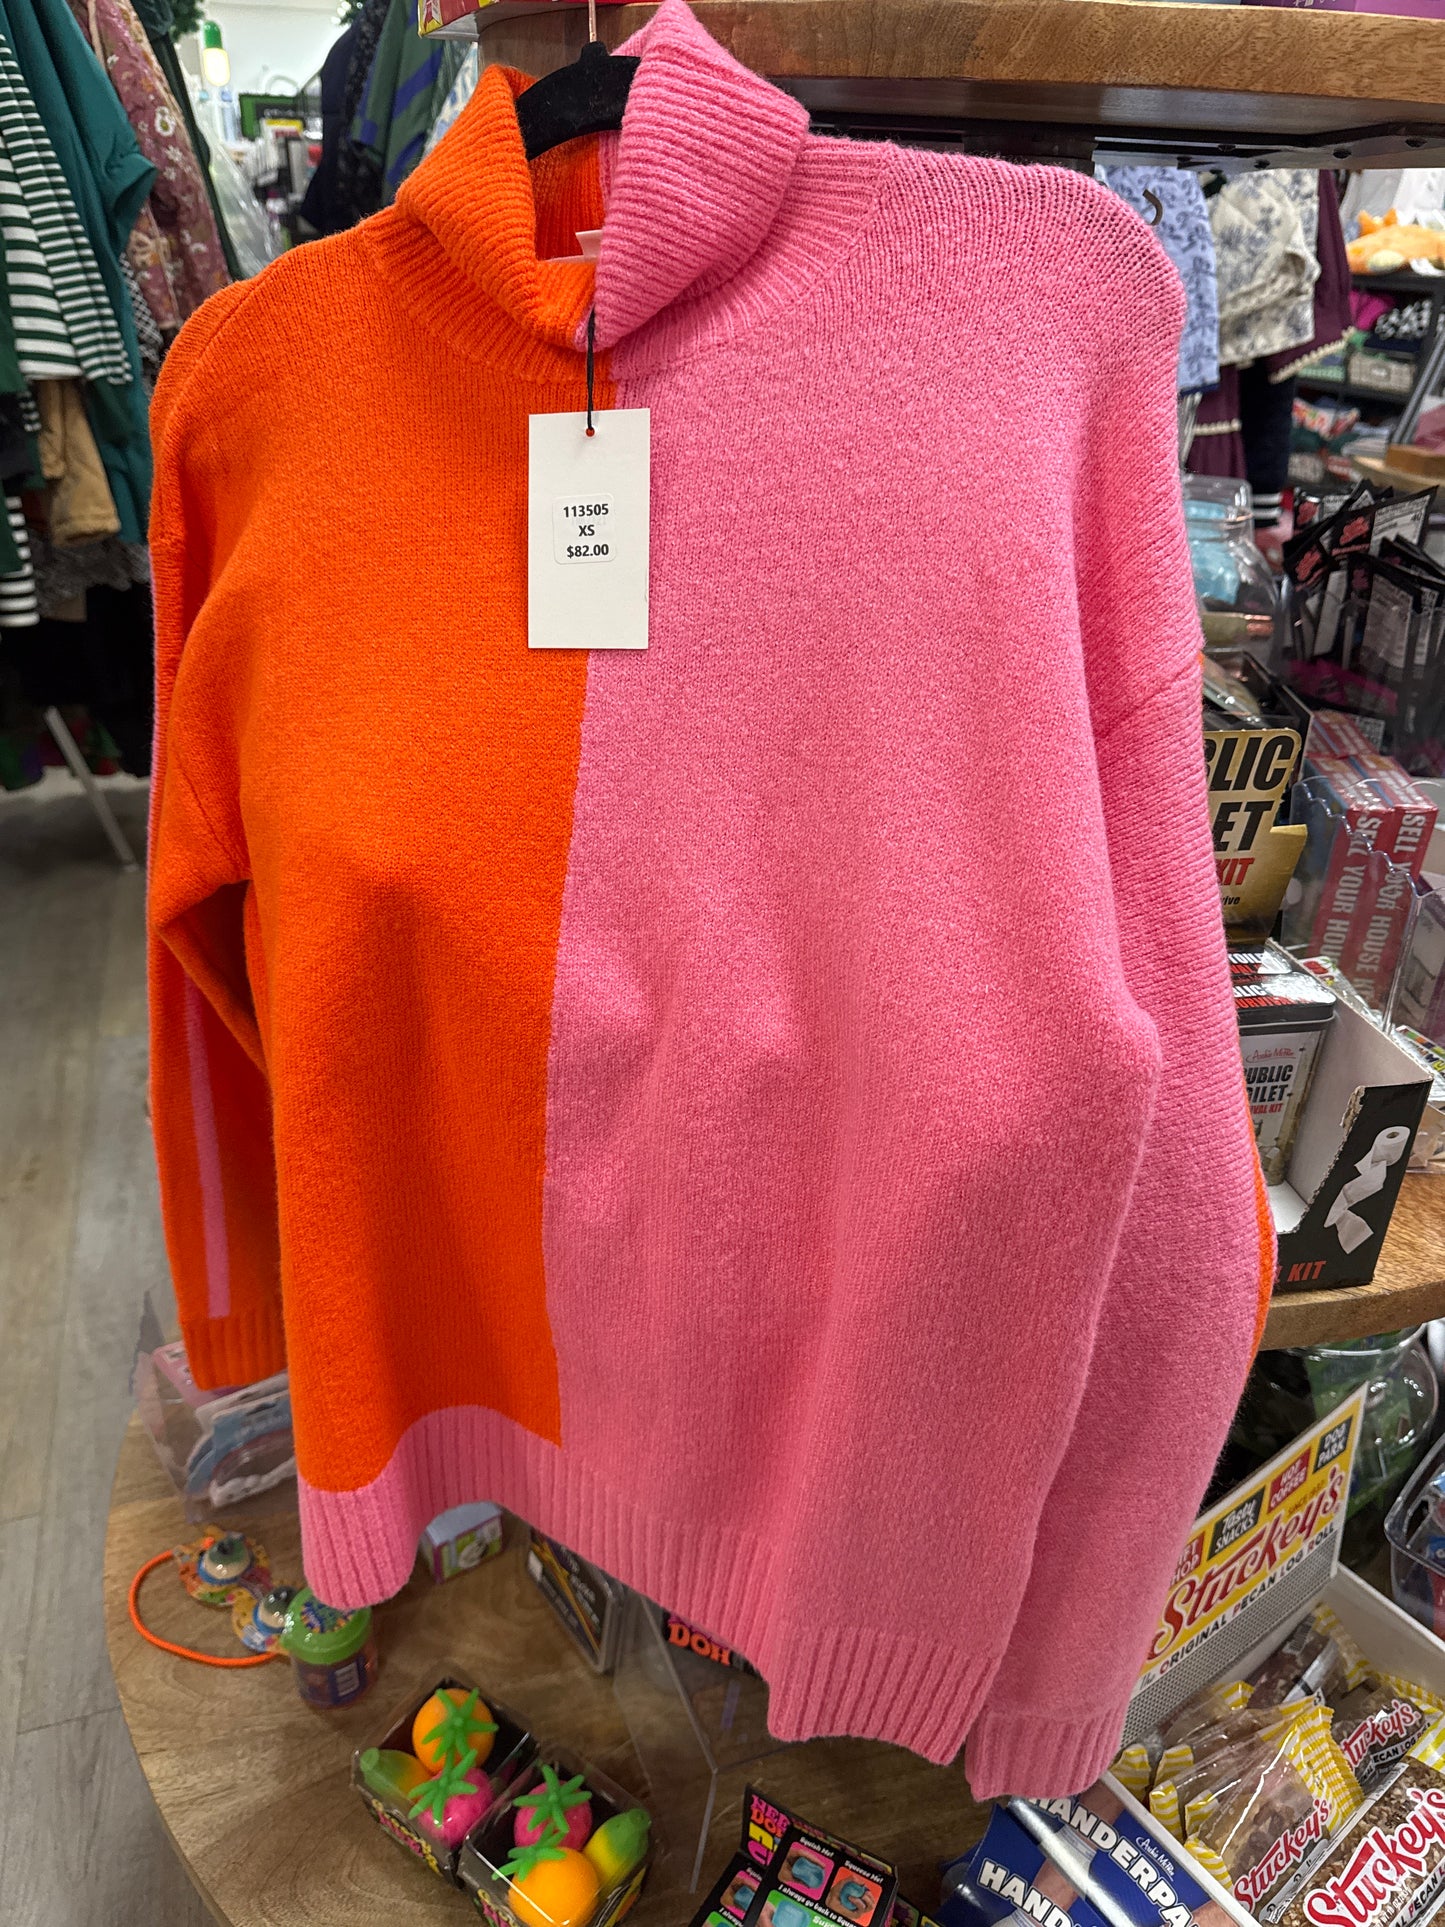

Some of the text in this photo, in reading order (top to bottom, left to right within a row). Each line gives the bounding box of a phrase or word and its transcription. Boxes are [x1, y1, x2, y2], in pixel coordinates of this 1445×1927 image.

[563, 503, 609, 518] 113505
[578, 525, 595, 537] XS
[566, 543, 609, 559] $82.00
[1393, 812, 1426, 853] SELL
[1332, 865, 1366, 913] YOUR
[1319, 918, 1351, 967] HOU
[1355, 915, 1393, 973] HOUSE
[1287, 1261, 1327, 1282] KIT
[1215, 1514, 1254, 1554] SNACKS
[1147, 1466, 1345, 1660] Stuckey's
[1159, 1614, 1227, 1675] ORIGINAL
[1232, 1573, 1276, 1617] PECAN
[1279, 1546, 1303, 1577] LOG
[1308, 1522, 1334, 1550] ROLL
[668, 1623, 732, 1666] DOH
[1341, 1700, 1415, 1768] tuckey's
[1025, 1797, 1200, 1927] HANDERPA
[1233, 1798, 1332, 1914] Stuckey's
[978, 1860, 1099, 1927] HAND
[1408, 1872, 1439, 1919] PECAN
